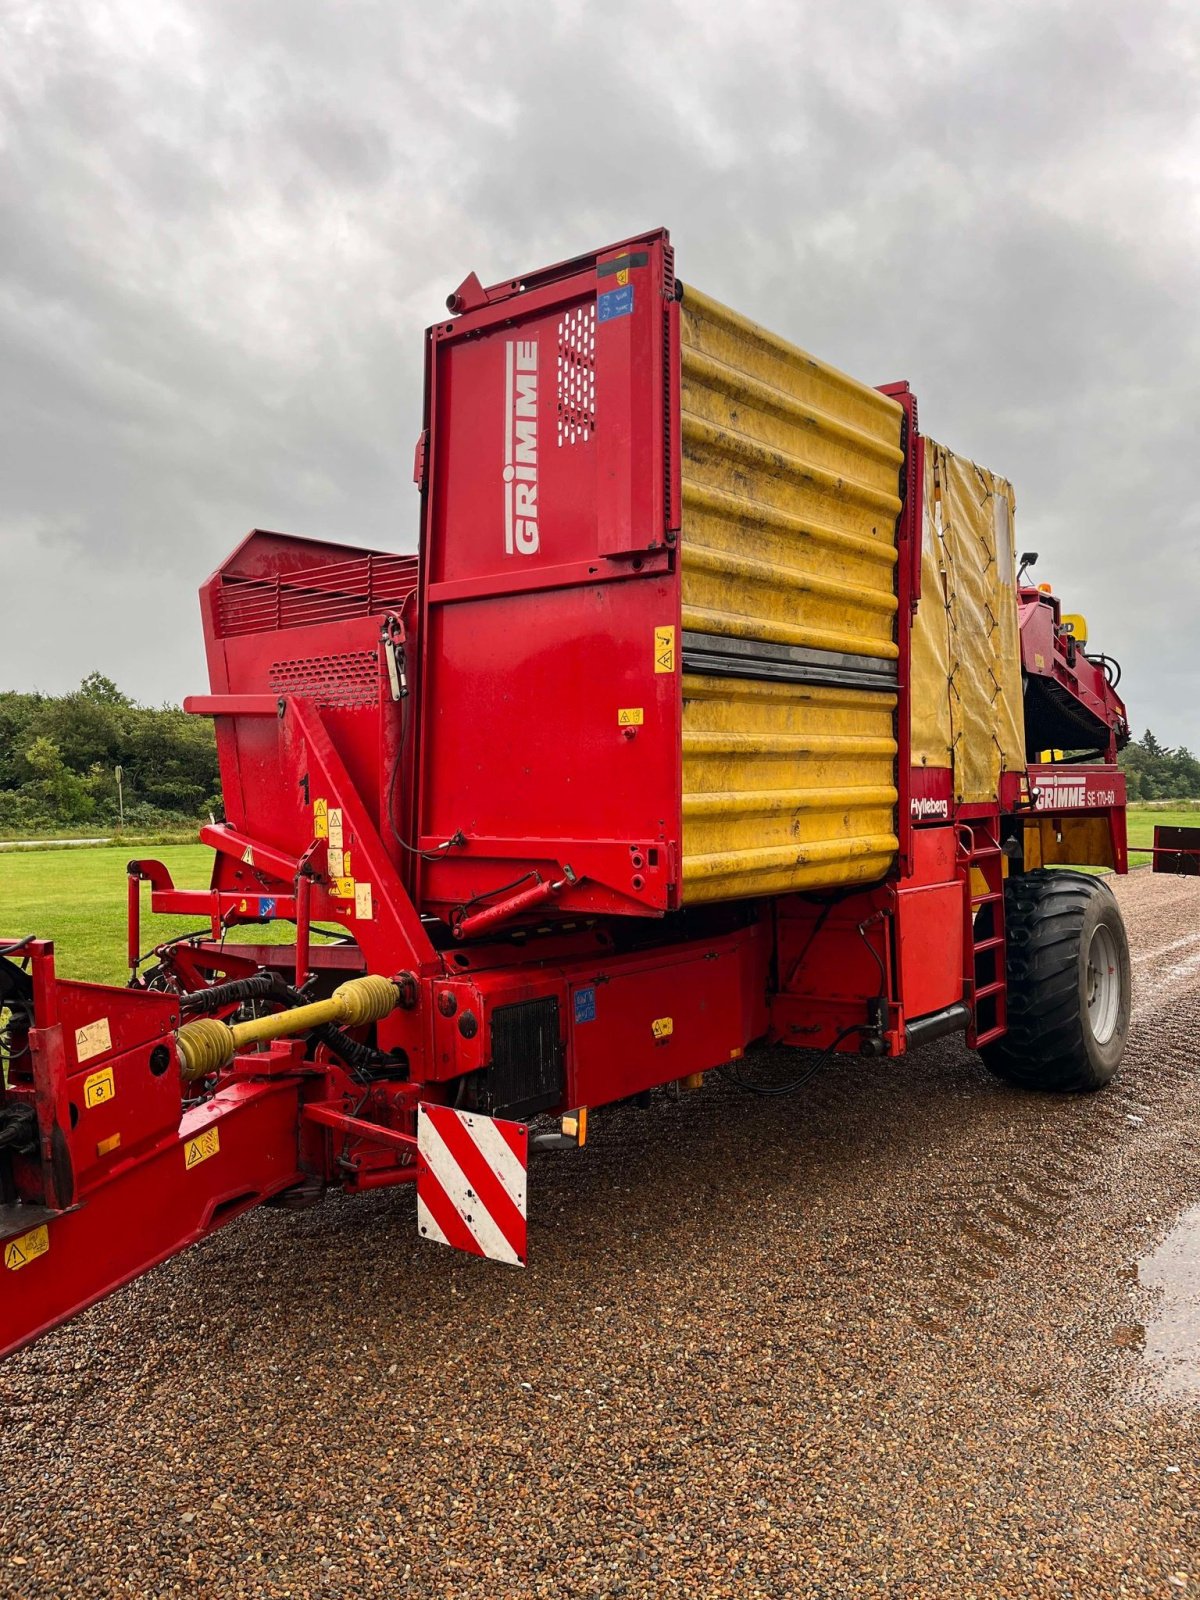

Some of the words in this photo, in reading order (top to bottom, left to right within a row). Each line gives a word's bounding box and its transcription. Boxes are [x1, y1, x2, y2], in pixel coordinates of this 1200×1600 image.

[1087, 791, 1096, 806] SE
[1096, 790, 1115, 805] 170-60
[910, 797, 948, 820] Hylleberg
